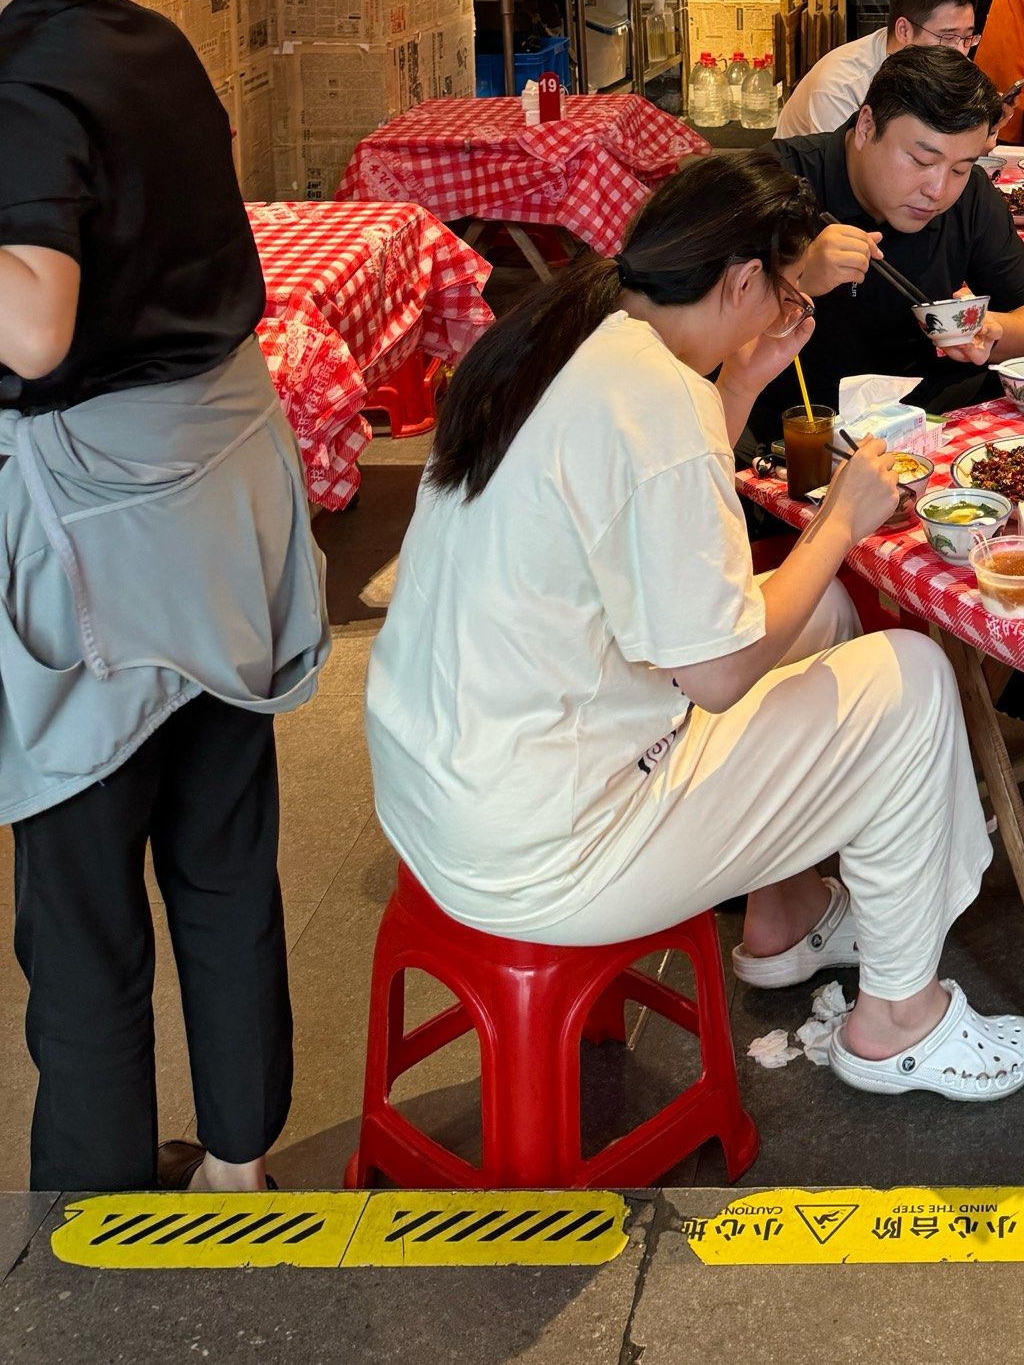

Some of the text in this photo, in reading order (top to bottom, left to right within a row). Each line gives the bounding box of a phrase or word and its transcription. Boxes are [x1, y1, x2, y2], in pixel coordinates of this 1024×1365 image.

[539, 78, 556, 93] 19
[941, 1062, 1023, 1091] crocs
[724, 1206, 783, 1215] CAUTION
[892, 1204, 998, 1214] MIND THE STEP
[871, 1215, 1017, 1239] 小心台阶
